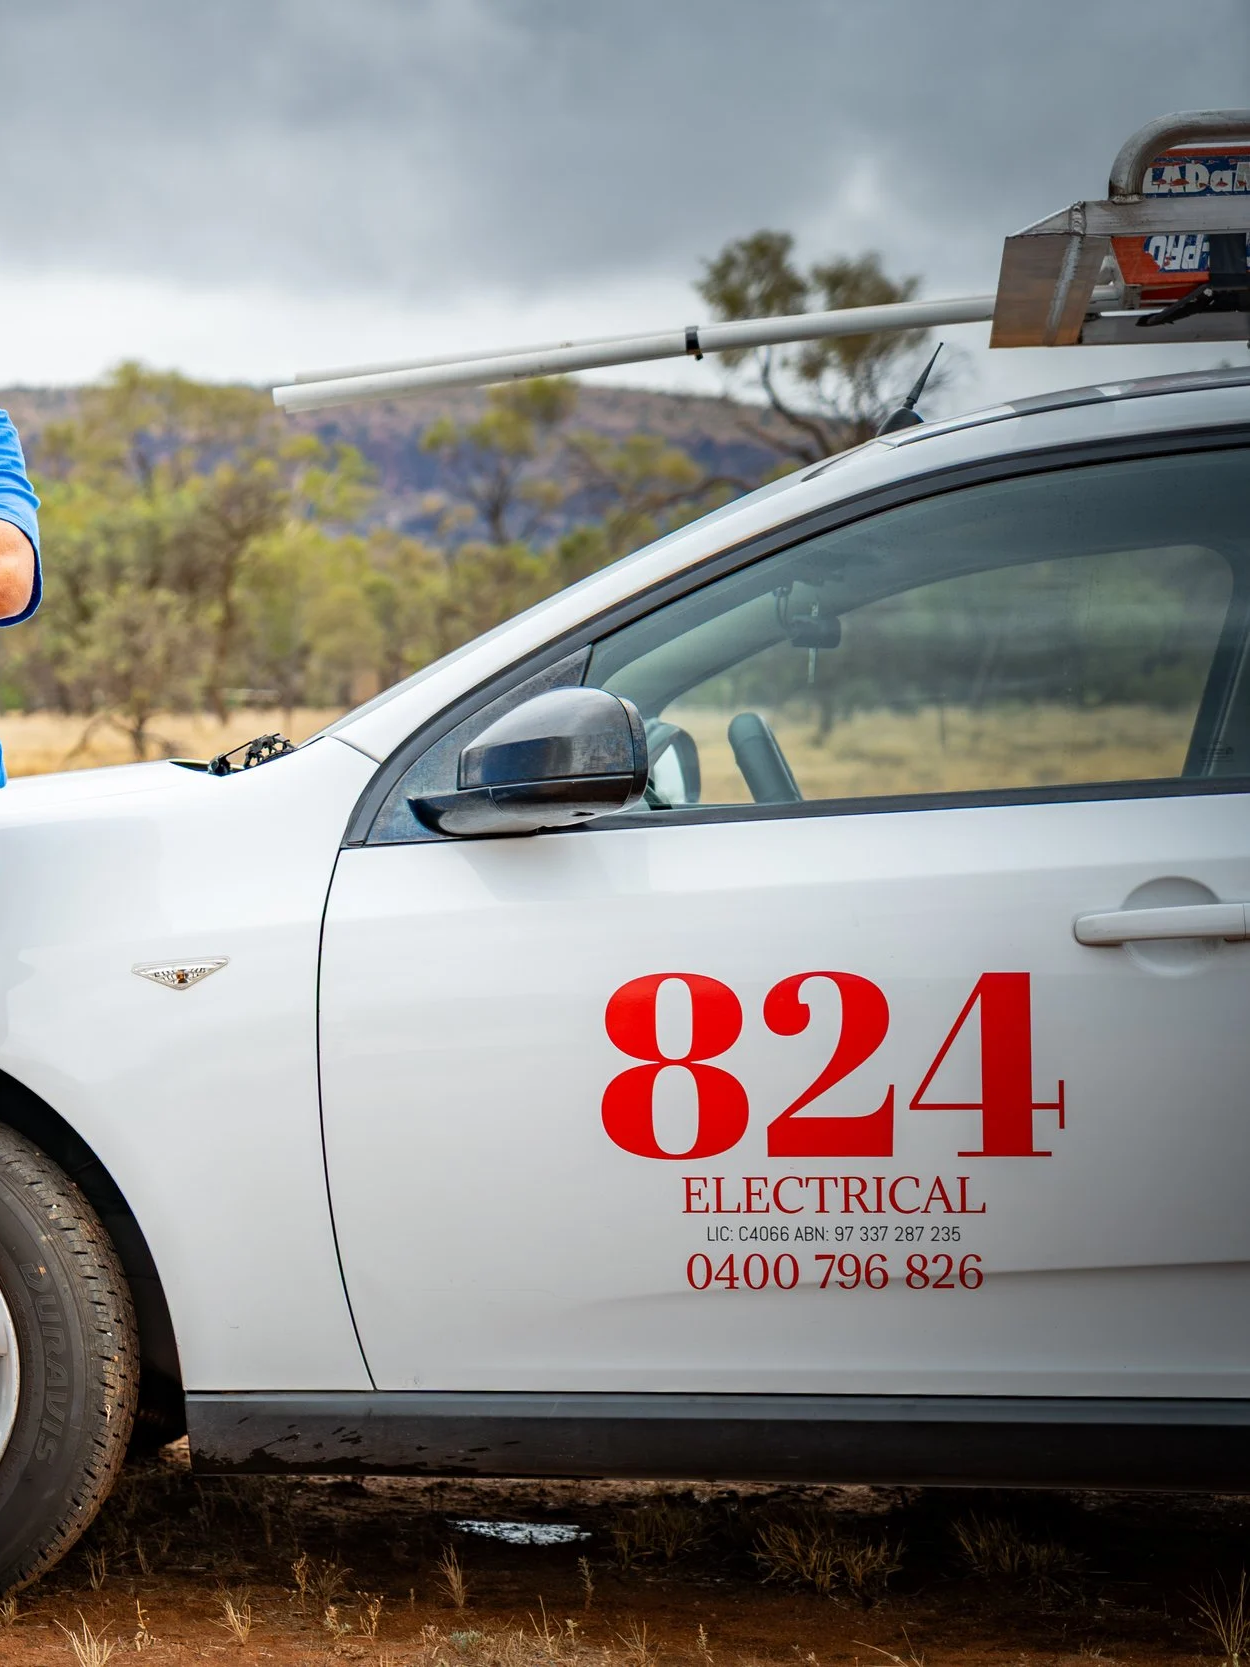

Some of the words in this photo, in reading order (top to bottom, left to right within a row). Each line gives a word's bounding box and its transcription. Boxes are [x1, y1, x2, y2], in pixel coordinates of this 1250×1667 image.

[601, 970, 1065, 1161] 824
[681, 1175, 987, 1215] ELECTRICAL
[707, 1225, 734, 1242] LIC:
[738, 1225, 790, 1242] C4066
[794, 1225, 829, 1242] ABN:
[834, 1225, 854, 1242] 97
[859, 1225, 889, 1242] 337
[894, 1225, 925, 1242] 287
[930, 1225, 962, 1242] 235
[686, 1253, 800, 1290] 0400
[814, 1253, 889, 1290] 796
[905, 1253, 984, 1290] 826
[19, 1263, 68, 1464] DURAVIS
